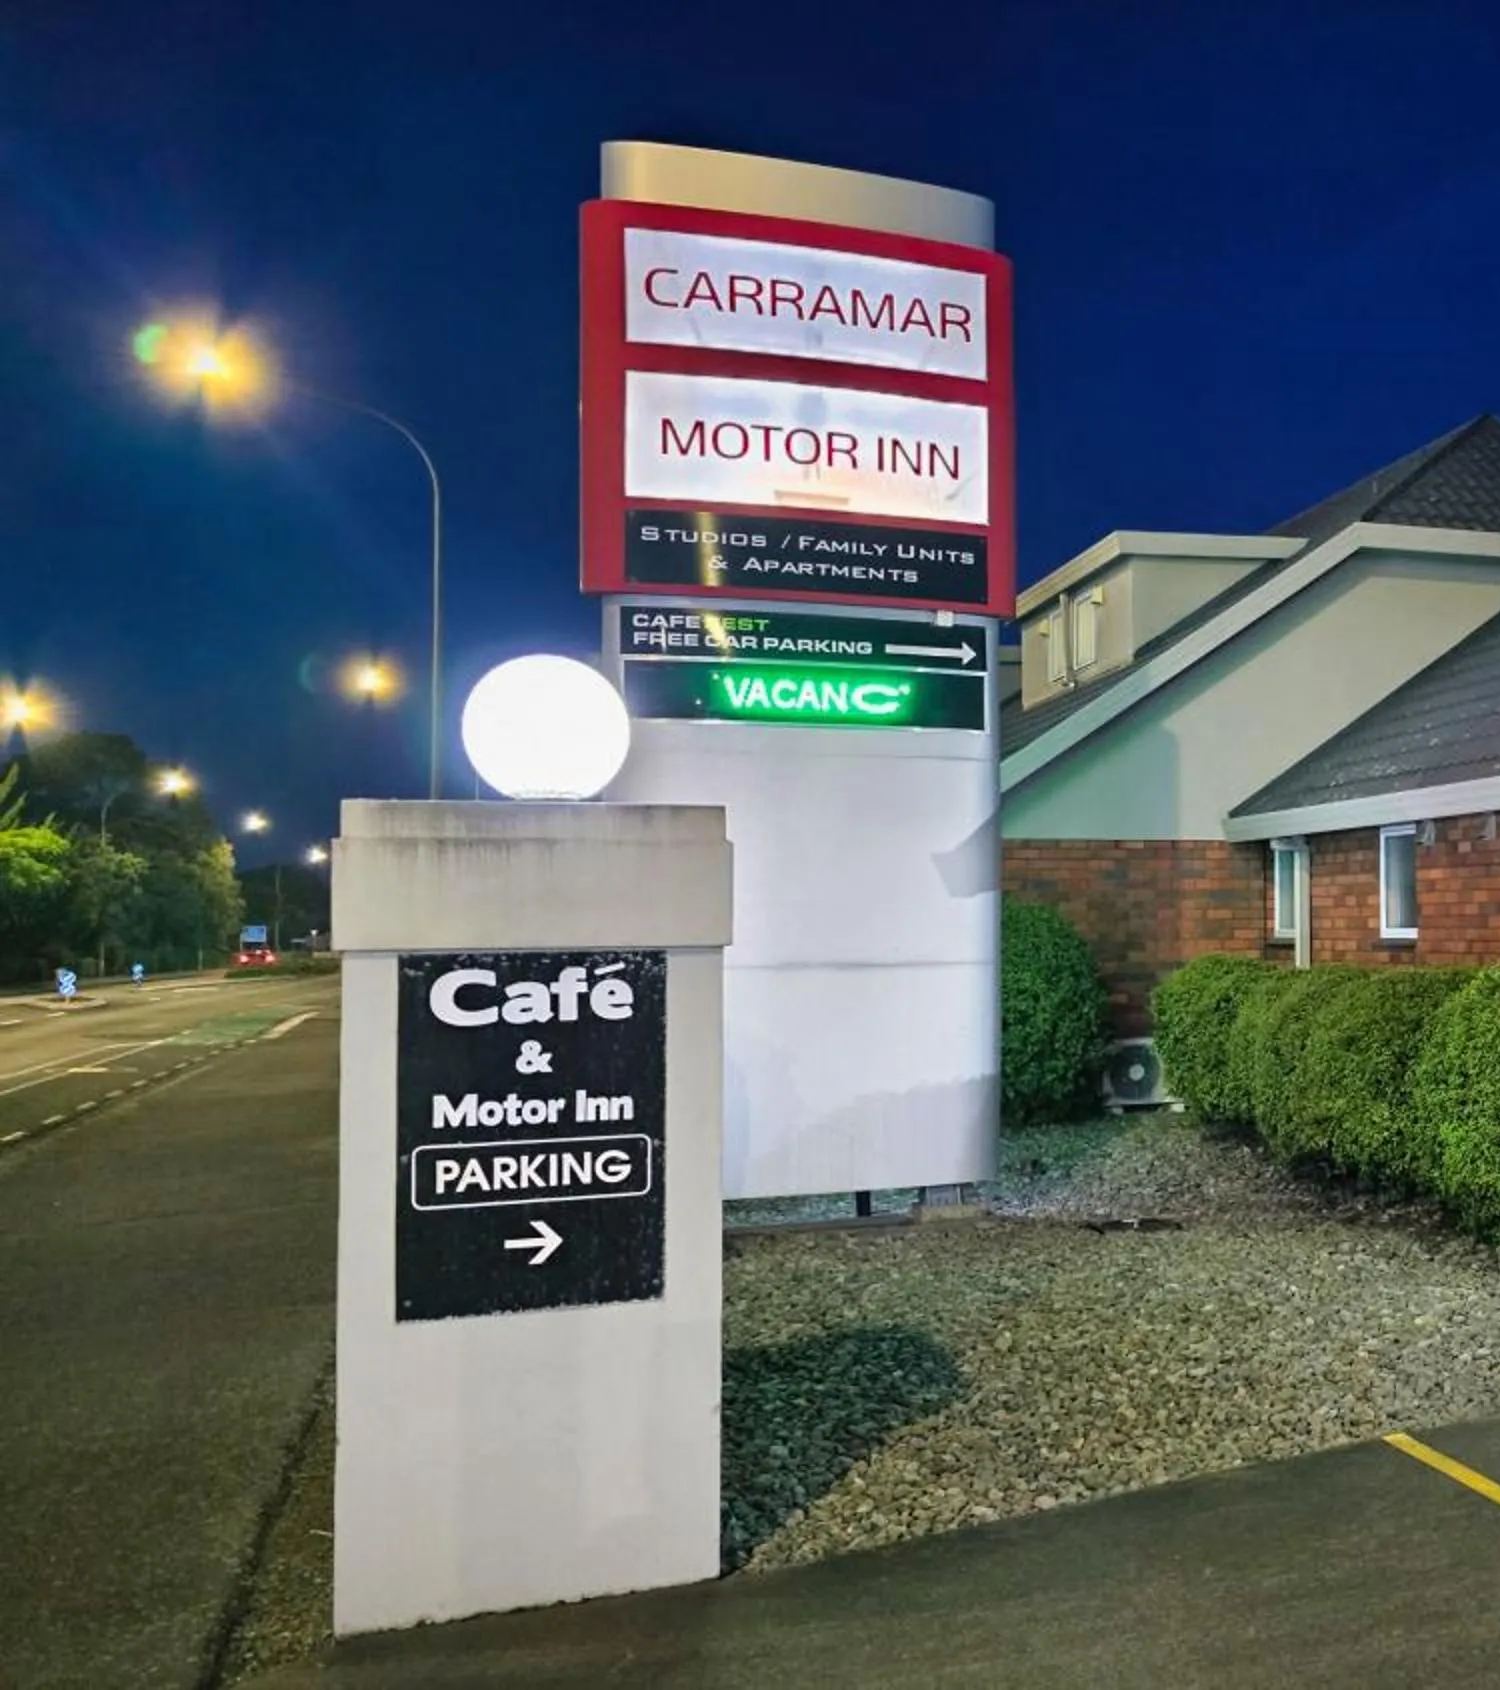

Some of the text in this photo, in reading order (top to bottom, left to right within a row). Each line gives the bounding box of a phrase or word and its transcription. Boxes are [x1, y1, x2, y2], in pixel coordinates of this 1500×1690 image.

[644, 267, 972, 343] CARRAMAR
[660, 417, 960, 480] MOTOR INN
[708, 554, 918, 583] & APARTMENTS
[799, 535, 888, 557] FAMILY
[898, 543, 975, 565] UNITS
[703, 614, 769, 632] EST
[633, 631, 873, 655] FREE CAR PARKING
[429, 962, 634, 1027] Café
[515, 1039, 553, 1074] &
[432, 1089, 634, 1129] Motor Inn
[435, 1150, 632, 1194] PARKING
